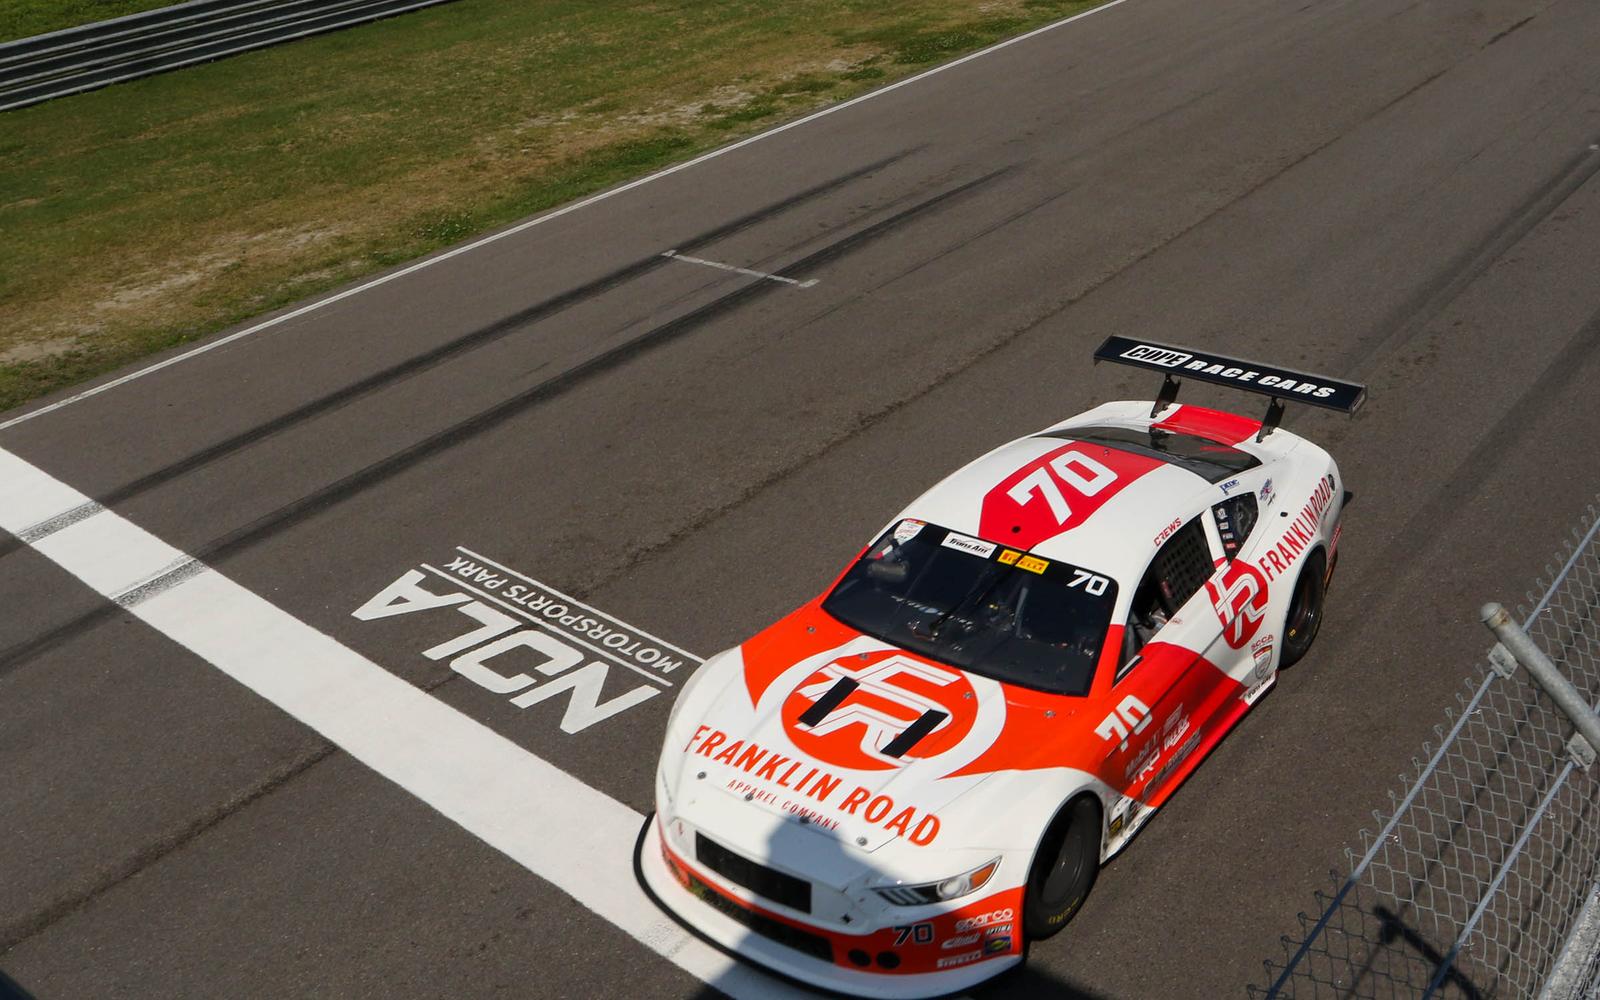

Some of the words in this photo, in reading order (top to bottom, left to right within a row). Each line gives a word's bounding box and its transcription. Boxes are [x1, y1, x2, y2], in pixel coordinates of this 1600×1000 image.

[1184, 359, 1259, 383] RACE
[1257, 375, 1336, 398] CARS
[1007, 450, 1119, 526] 70
[1153, 517, 1183, 547] CREWS
[1258, 503, 1321, 582] FRANKLIN
[1310, 477, 1331, 517] ROAD
[443, 556, 504, 589] PARK
[1067, 570, 1110, 596] 70
[502, 584, 683, 674] MOTORSPORTS
[1094, 694, 1153, 752] 70
[684, 724, 843, 802] FRANKLIN
[838, 786, 942, 847] ROAD
[727, 779, 776, 805] APPAREL
[781, 800, 840, 831] COMPANY
[893, 921, 935, 946] 70
[955, 908, 1014, 932] sparco
